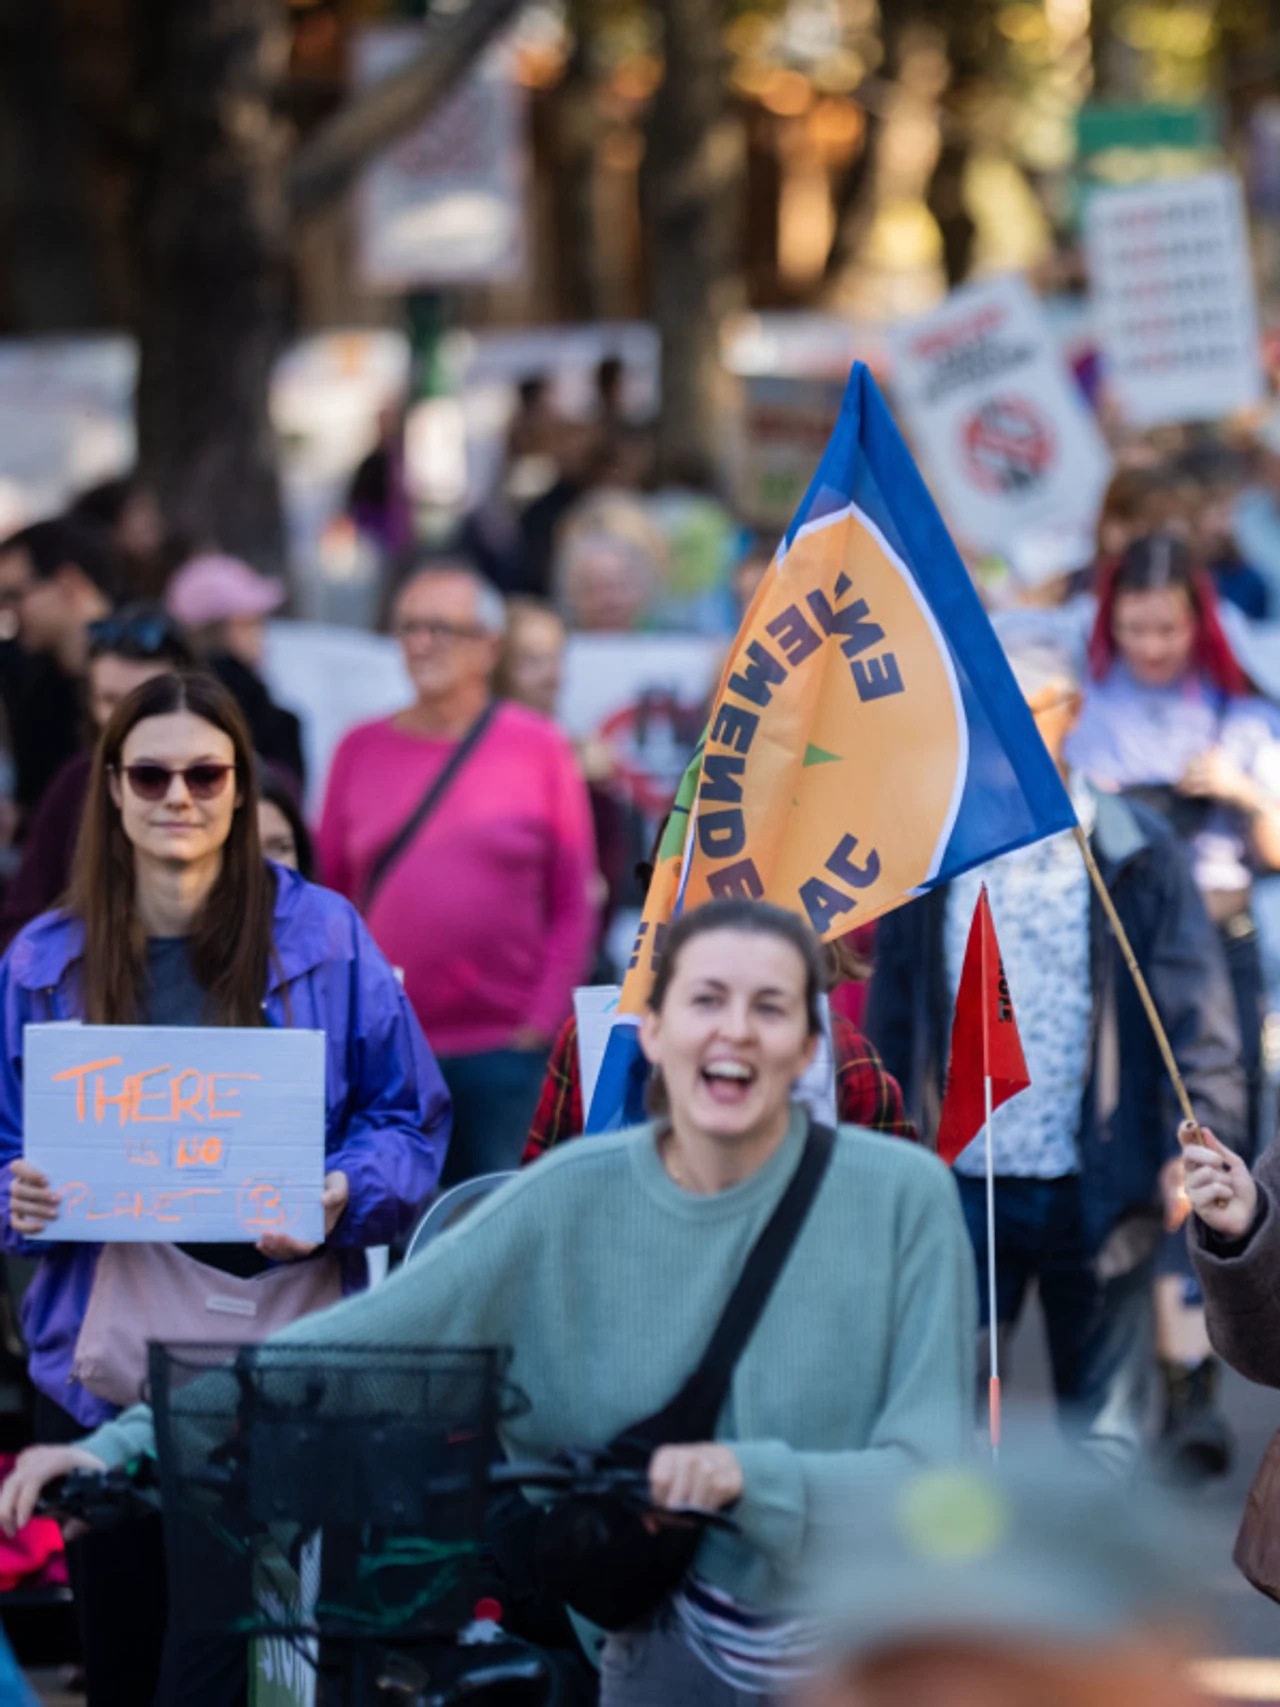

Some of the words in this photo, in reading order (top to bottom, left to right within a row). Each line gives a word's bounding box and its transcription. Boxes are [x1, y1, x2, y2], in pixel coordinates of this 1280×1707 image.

[52, 1055, 261, 1127] THERE
[175, 1136, 223, 1169] NO
[245, 1184, 285, 1225] B
